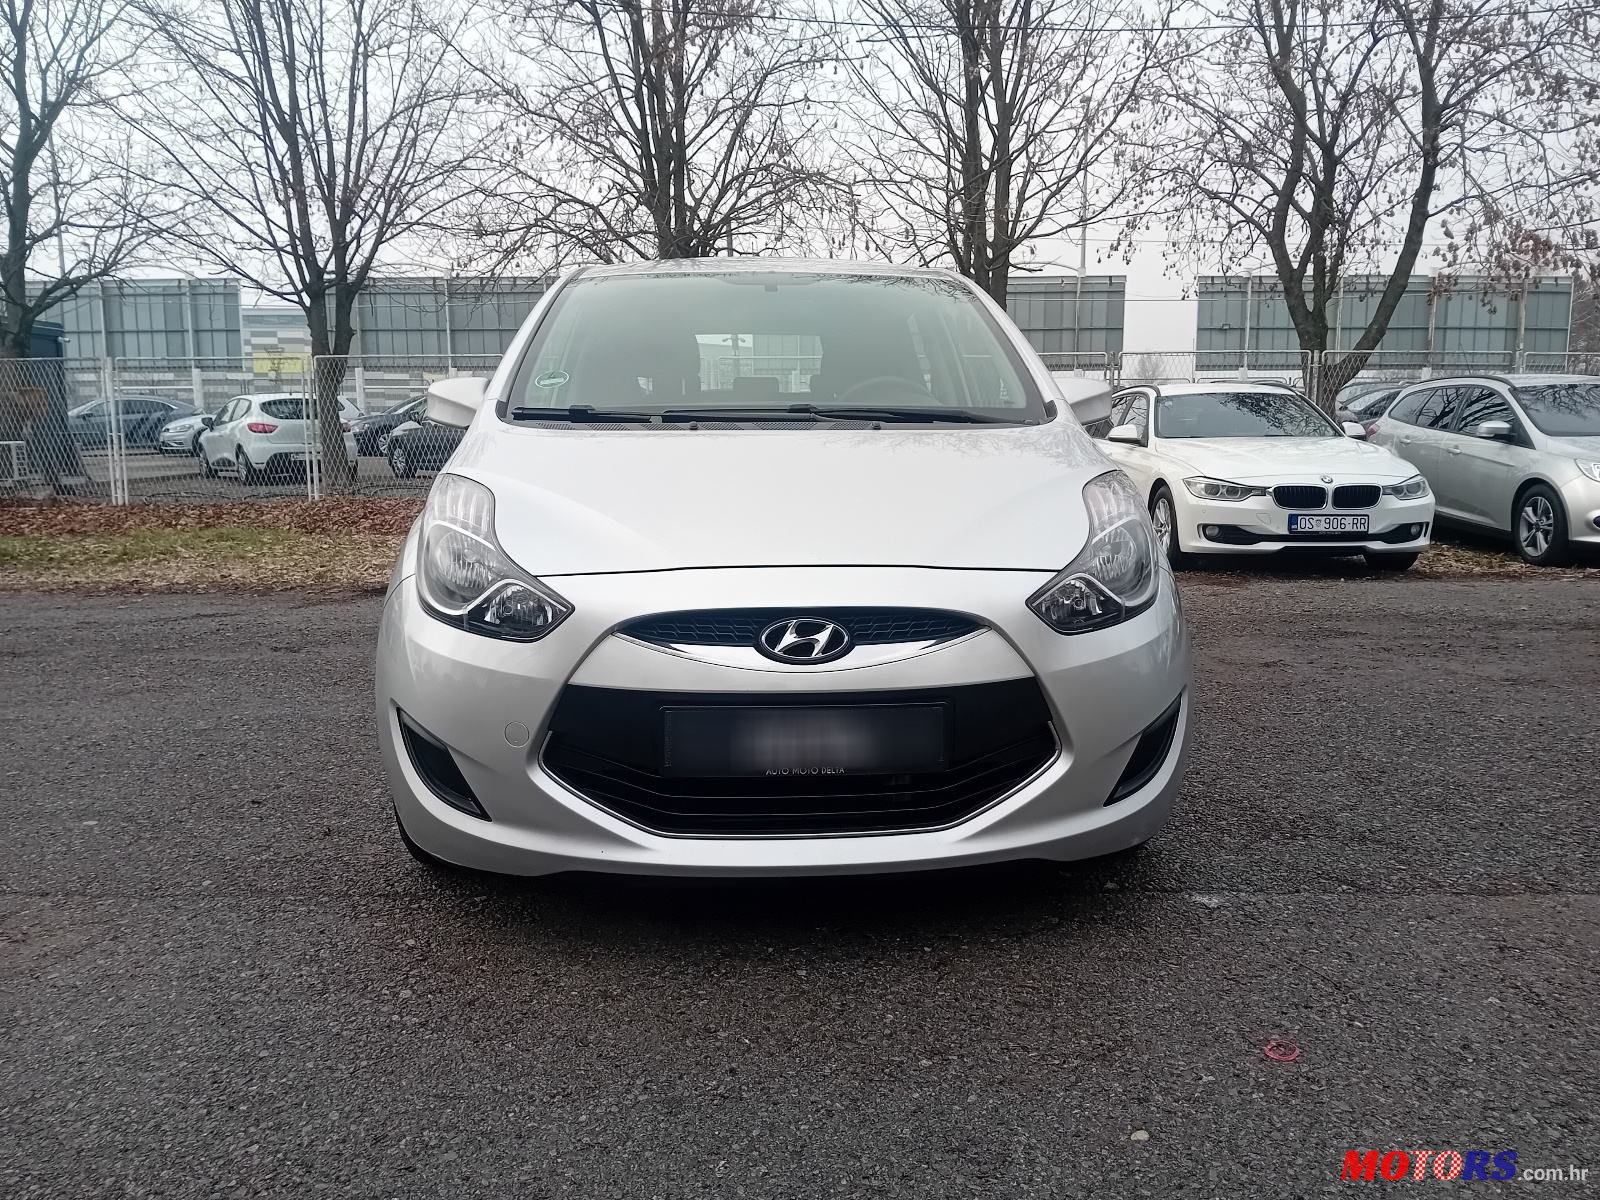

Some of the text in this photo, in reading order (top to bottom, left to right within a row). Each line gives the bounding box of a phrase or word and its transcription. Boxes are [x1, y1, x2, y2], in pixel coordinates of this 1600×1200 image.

[1299, 517, 1367, 530] OS 906-RR
[765, 766, 845, 776] AUTO MOTO DELTA
